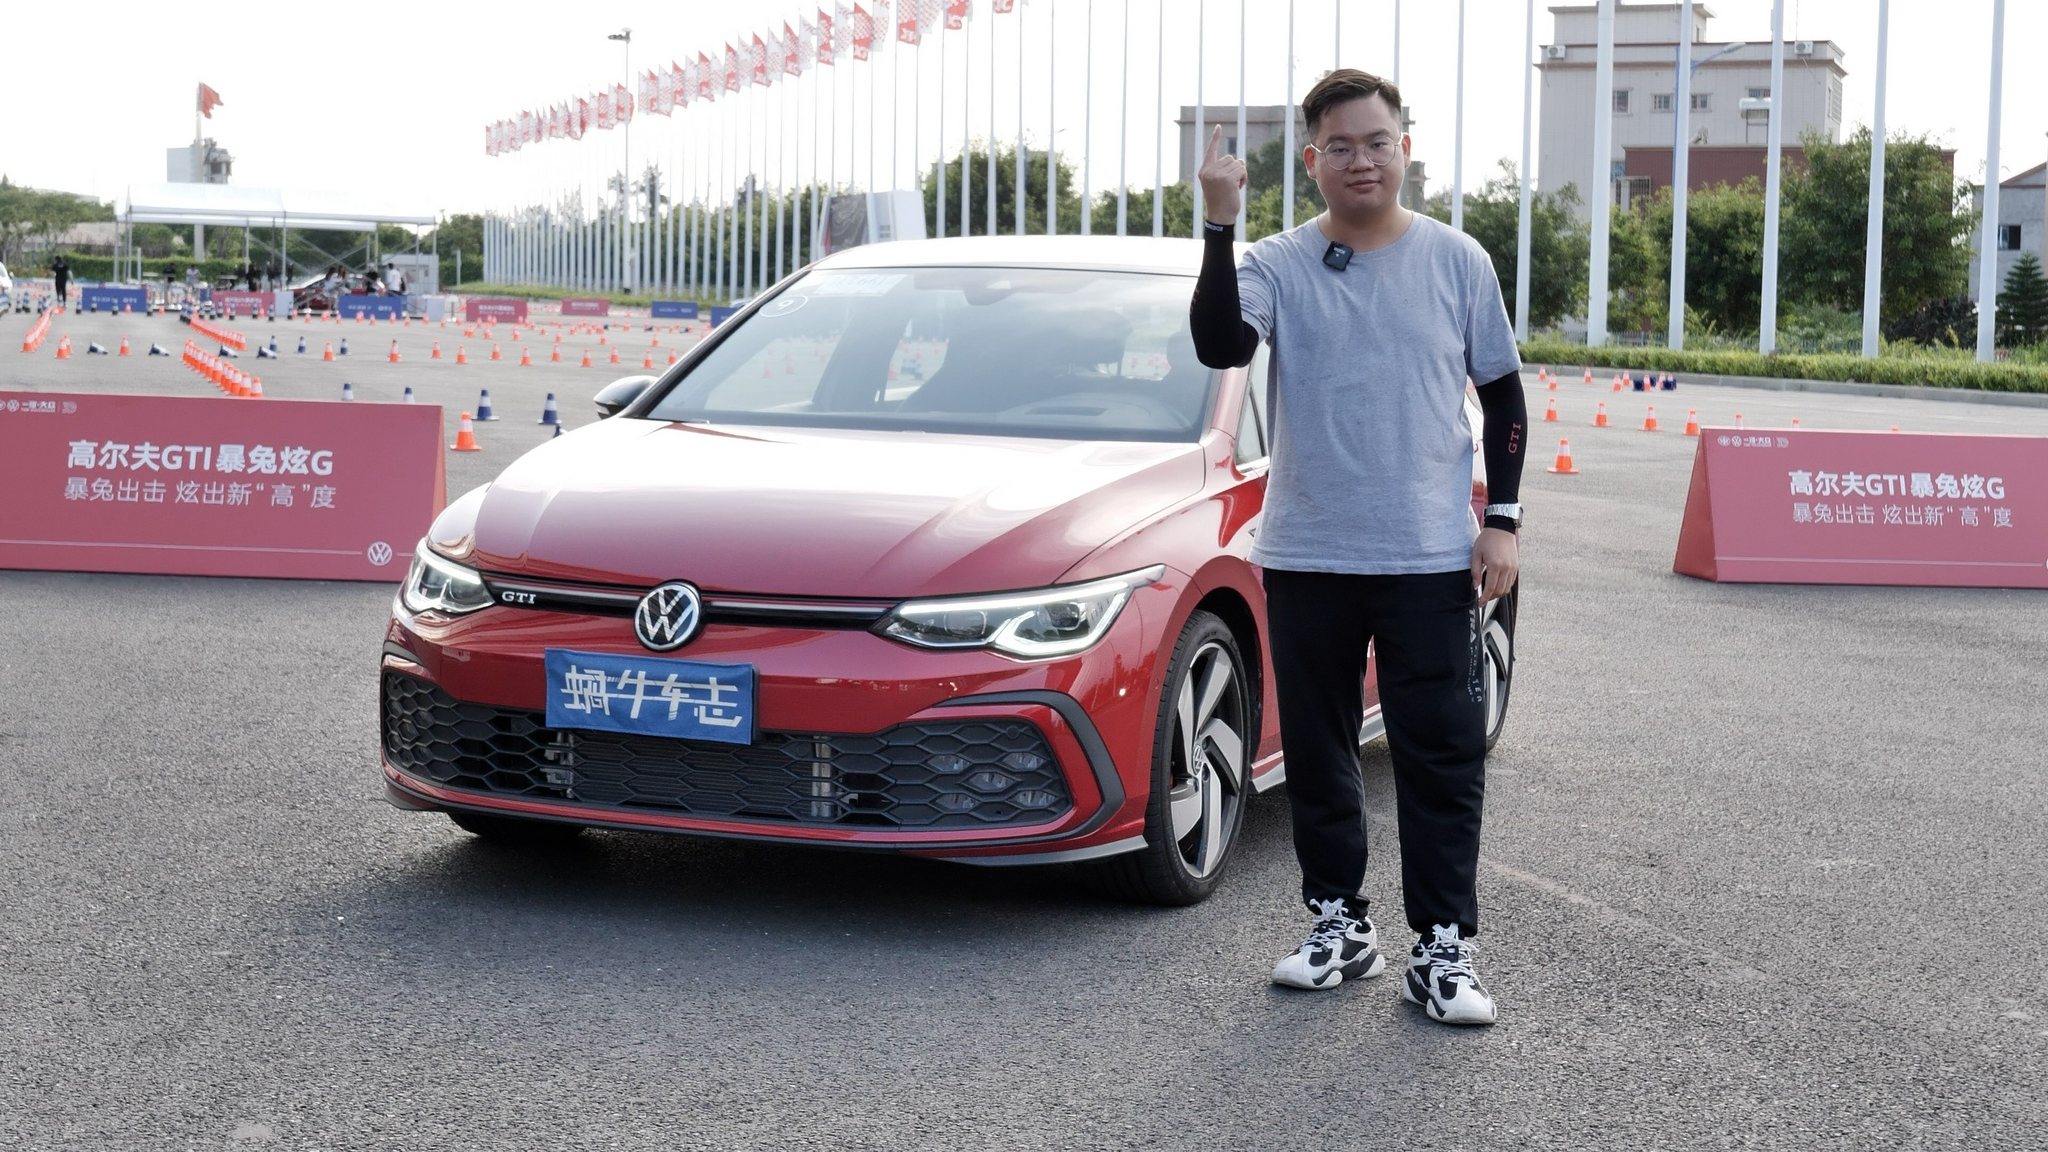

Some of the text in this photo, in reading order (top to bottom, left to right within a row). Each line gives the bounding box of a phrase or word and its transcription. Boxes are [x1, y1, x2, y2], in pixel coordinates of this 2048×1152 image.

[1508, 422, 1521, 454] GTI
[67, 439, 333, 476] 高尔夫GTI暴兔炫G
[64, 476, 167, 504] 暴兔出击
[1788, 470, 2005, 500] 高尔夫GTI暴兔炫G
[1792, 502, 1875, 525] 暴兔出击
[501, 591, 537, 605] GTI
